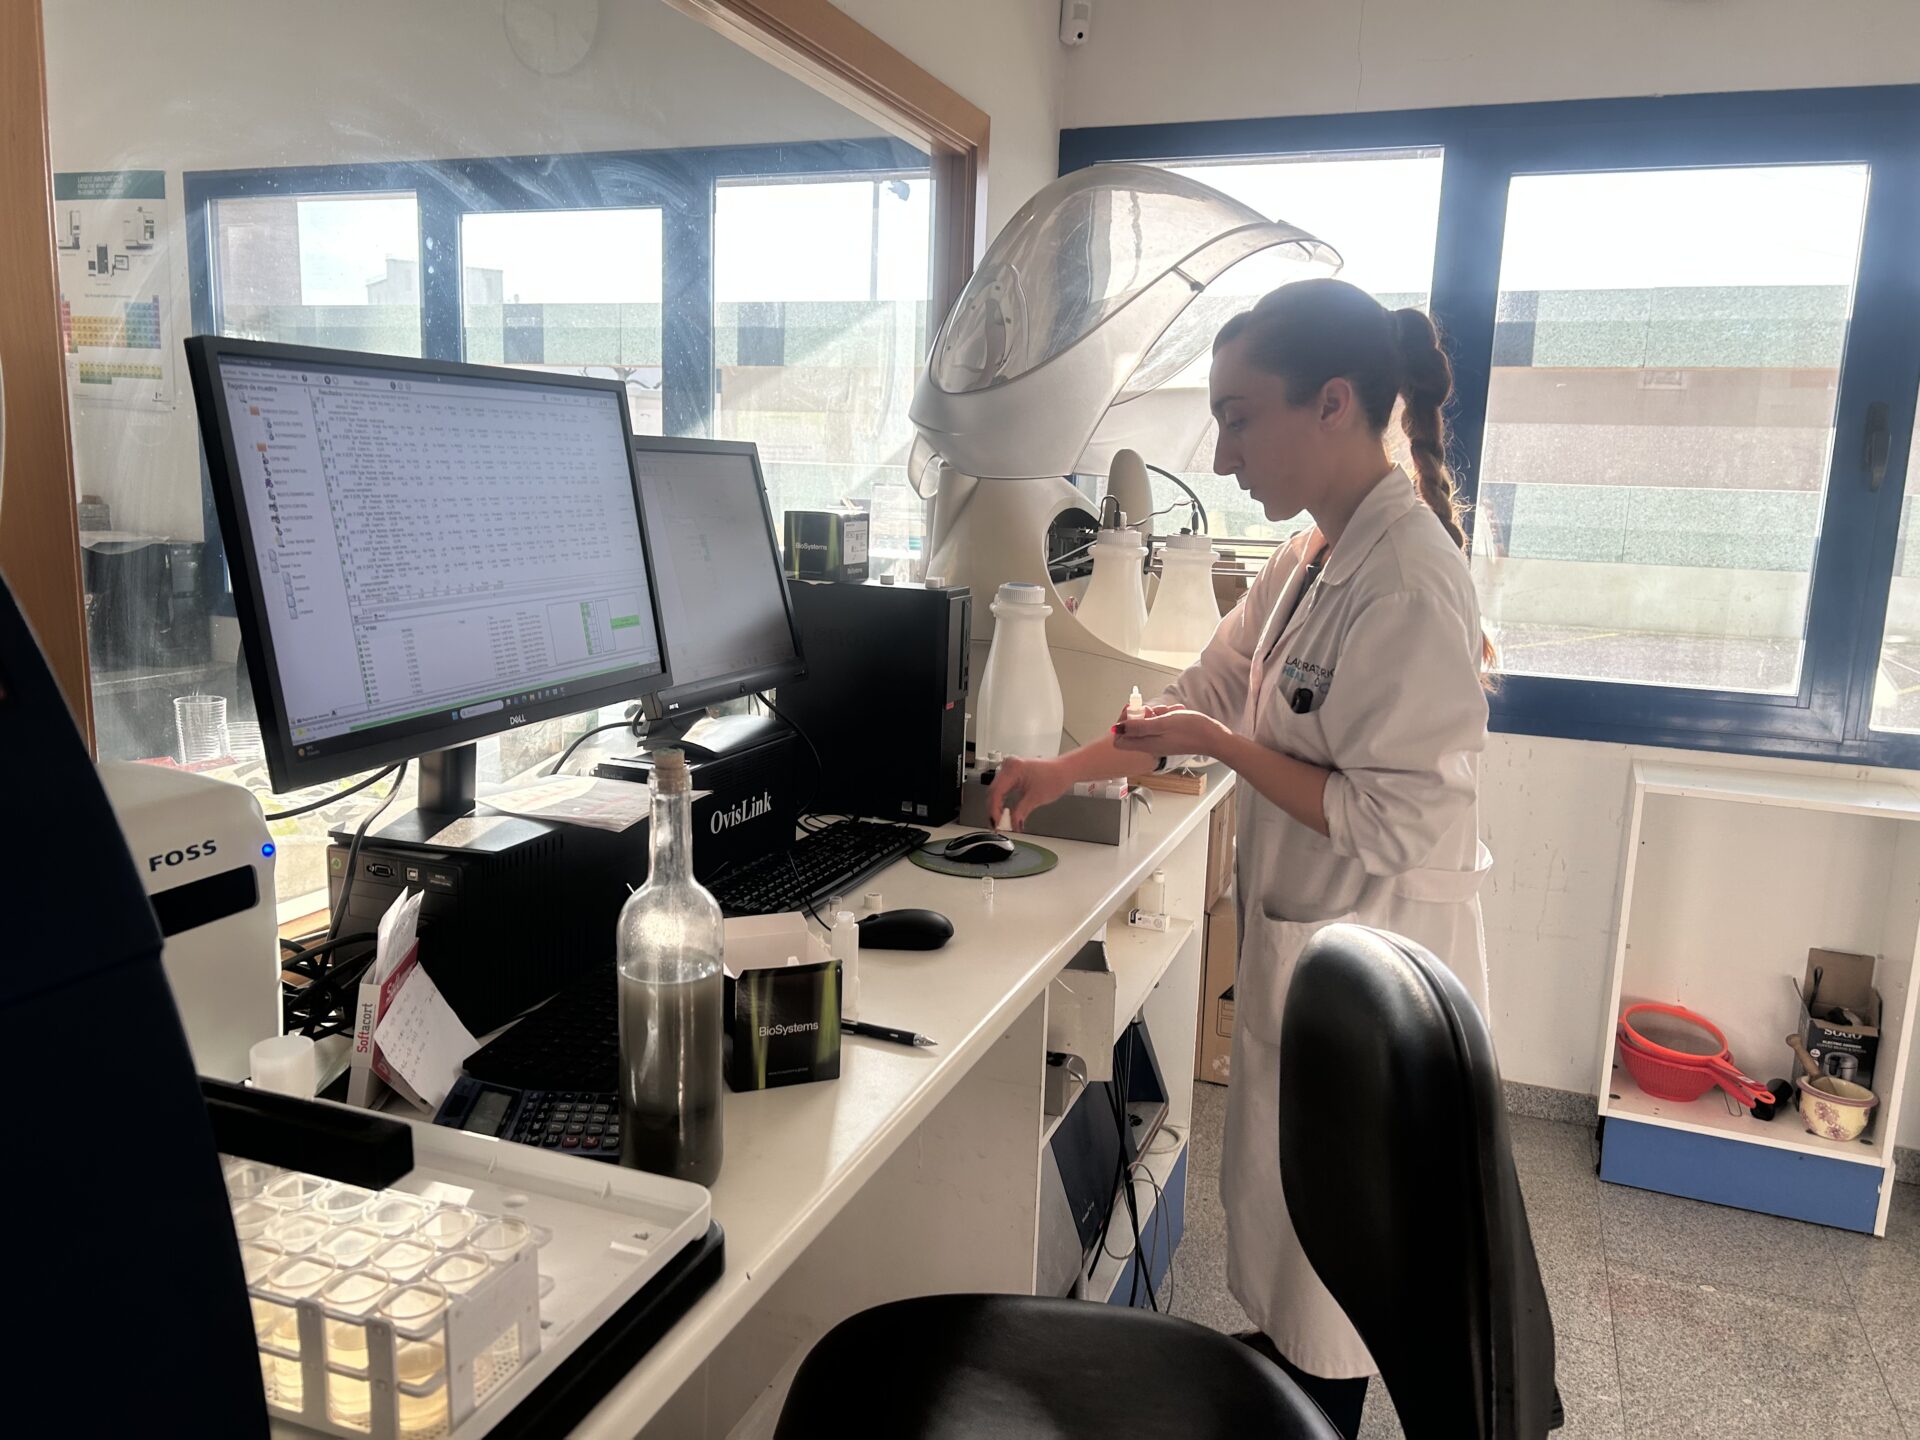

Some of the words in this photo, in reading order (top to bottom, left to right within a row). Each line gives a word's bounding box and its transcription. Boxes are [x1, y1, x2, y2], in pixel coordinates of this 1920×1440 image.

[795, 542, 828, 551] BioSystems
[509, 713, 526, 726] DELL
[710, 791, 772, 835] OvisLink
[149, 839, 217, 872] FOSS
[356, 1002, 373, 1054] Softacort
[759, 1021, 819, 1037] BioSystems
